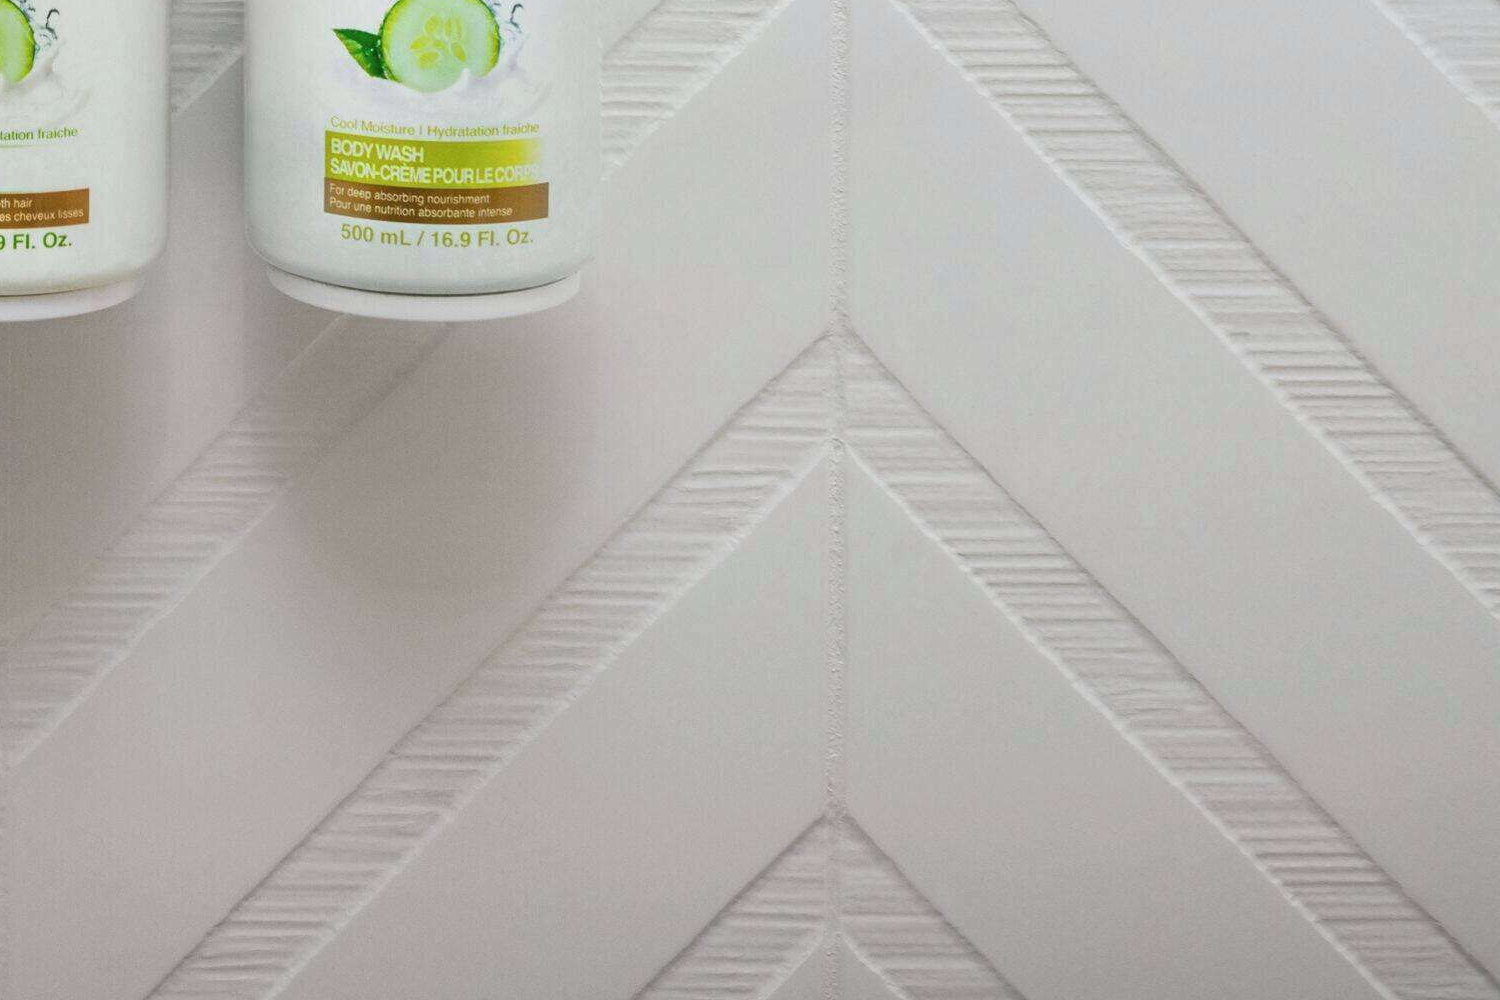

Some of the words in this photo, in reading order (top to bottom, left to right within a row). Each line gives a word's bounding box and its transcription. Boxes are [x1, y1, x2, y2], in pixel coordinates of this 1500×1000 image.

[331, 116, 356, 129] Cool
[362, 121, 415, 135] Moisture
[428, 125, 499, 139] Hydratation
[331, 138, 373, 158] BODY
[375, 144, 424, 162] WASH
[433, 167, 473, 184] POUR
[476, 167, 494, 184] LE
[14, 197, 32, 207] hair
[330, 183, 344, 195] For
[347, 186, 372, 201] deep
[375, 190, 424, 205] absorbing
[427, 195, 490, 204] nourishment
[14, 211, 55, 221] cheveux
[58, 208, 84, 218] lisses
[330, 196, 350, 210] Pour
[354, 203, 372, 213] une
[375, 204, 415, 216] nutrition
[418, 207, 474, 217] absorbante
[478, 207, 513, 217] intense
[14, 234, 35, 249] Fl.
[43, 232, 71, 248] Oz.
[341, 224, 373, 241] 500
[381, 231, 410, 245] mL
[417, 231, 424, 245] /
[432, 232, 471, 247] 16.9
[478, 231, 499, 246] Fl.
[507, 229, 533, 244] Oz.
